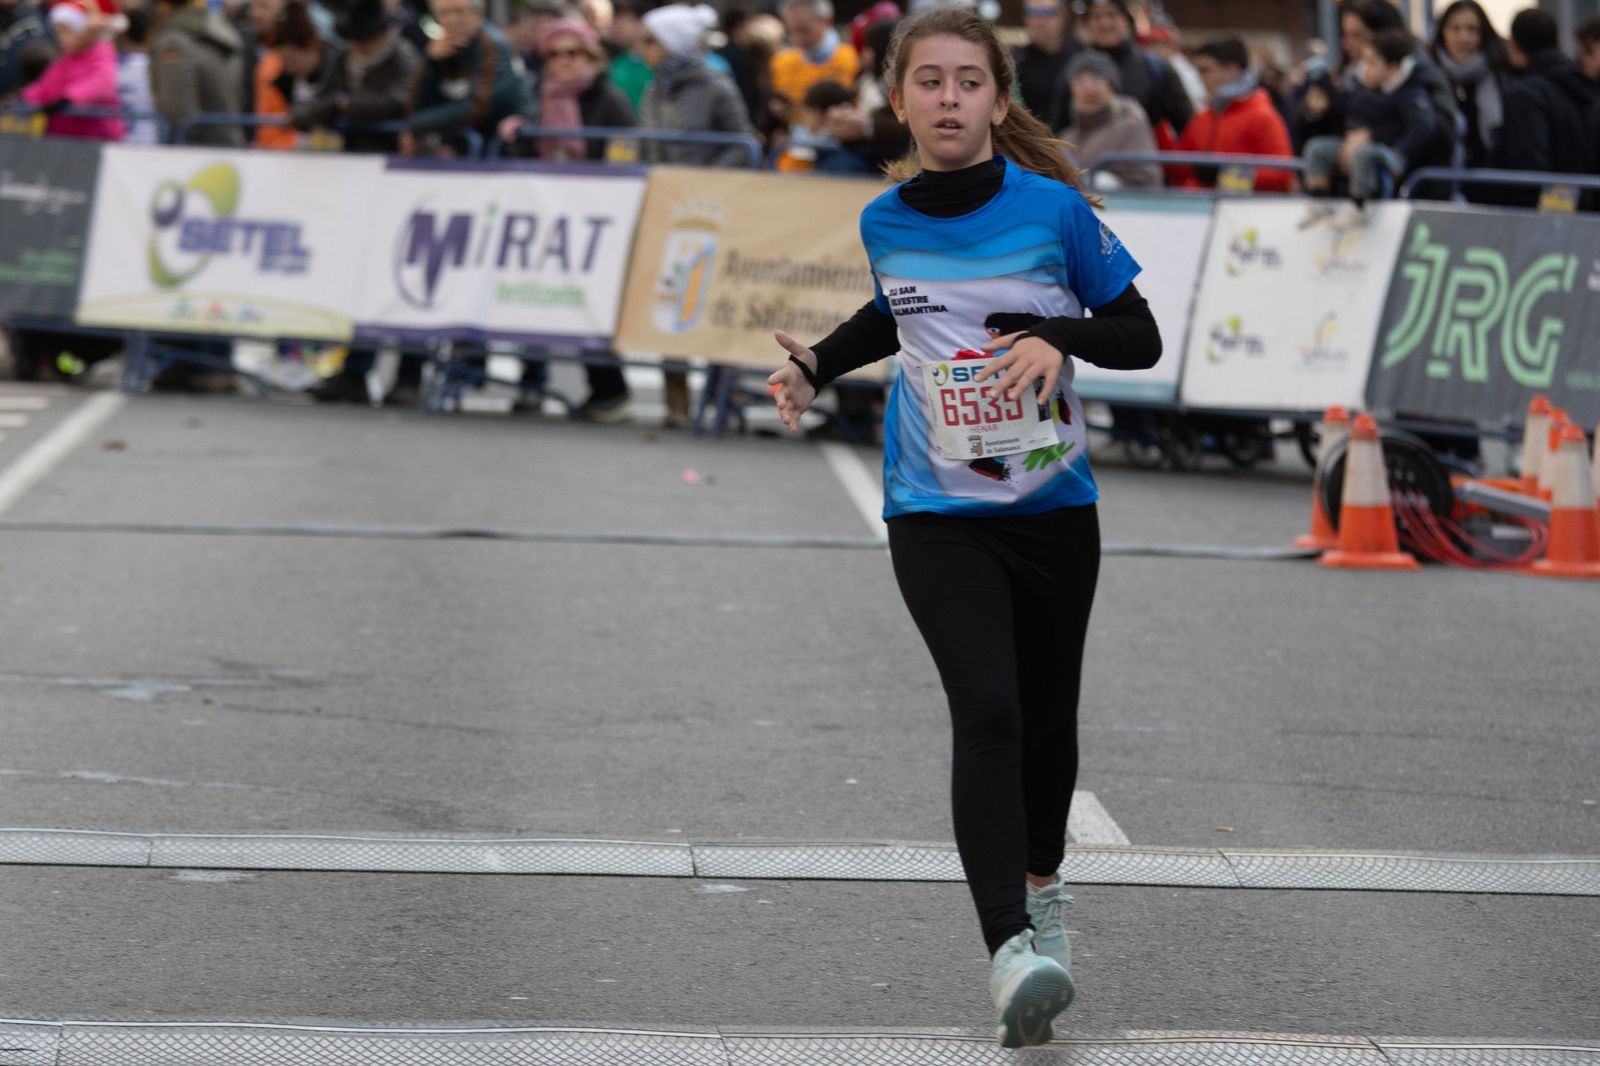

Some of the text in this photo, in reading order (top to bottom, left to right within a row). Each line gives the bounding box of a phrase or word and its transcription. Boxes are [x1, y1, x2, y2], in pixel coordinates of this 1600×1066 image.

[179, 216, 313, 257] SETEL
[725, 248, 873, 292] Ayuntamient
[899, 286, 916, 295] SAN
[970, 424, 998, 433] HENAR
